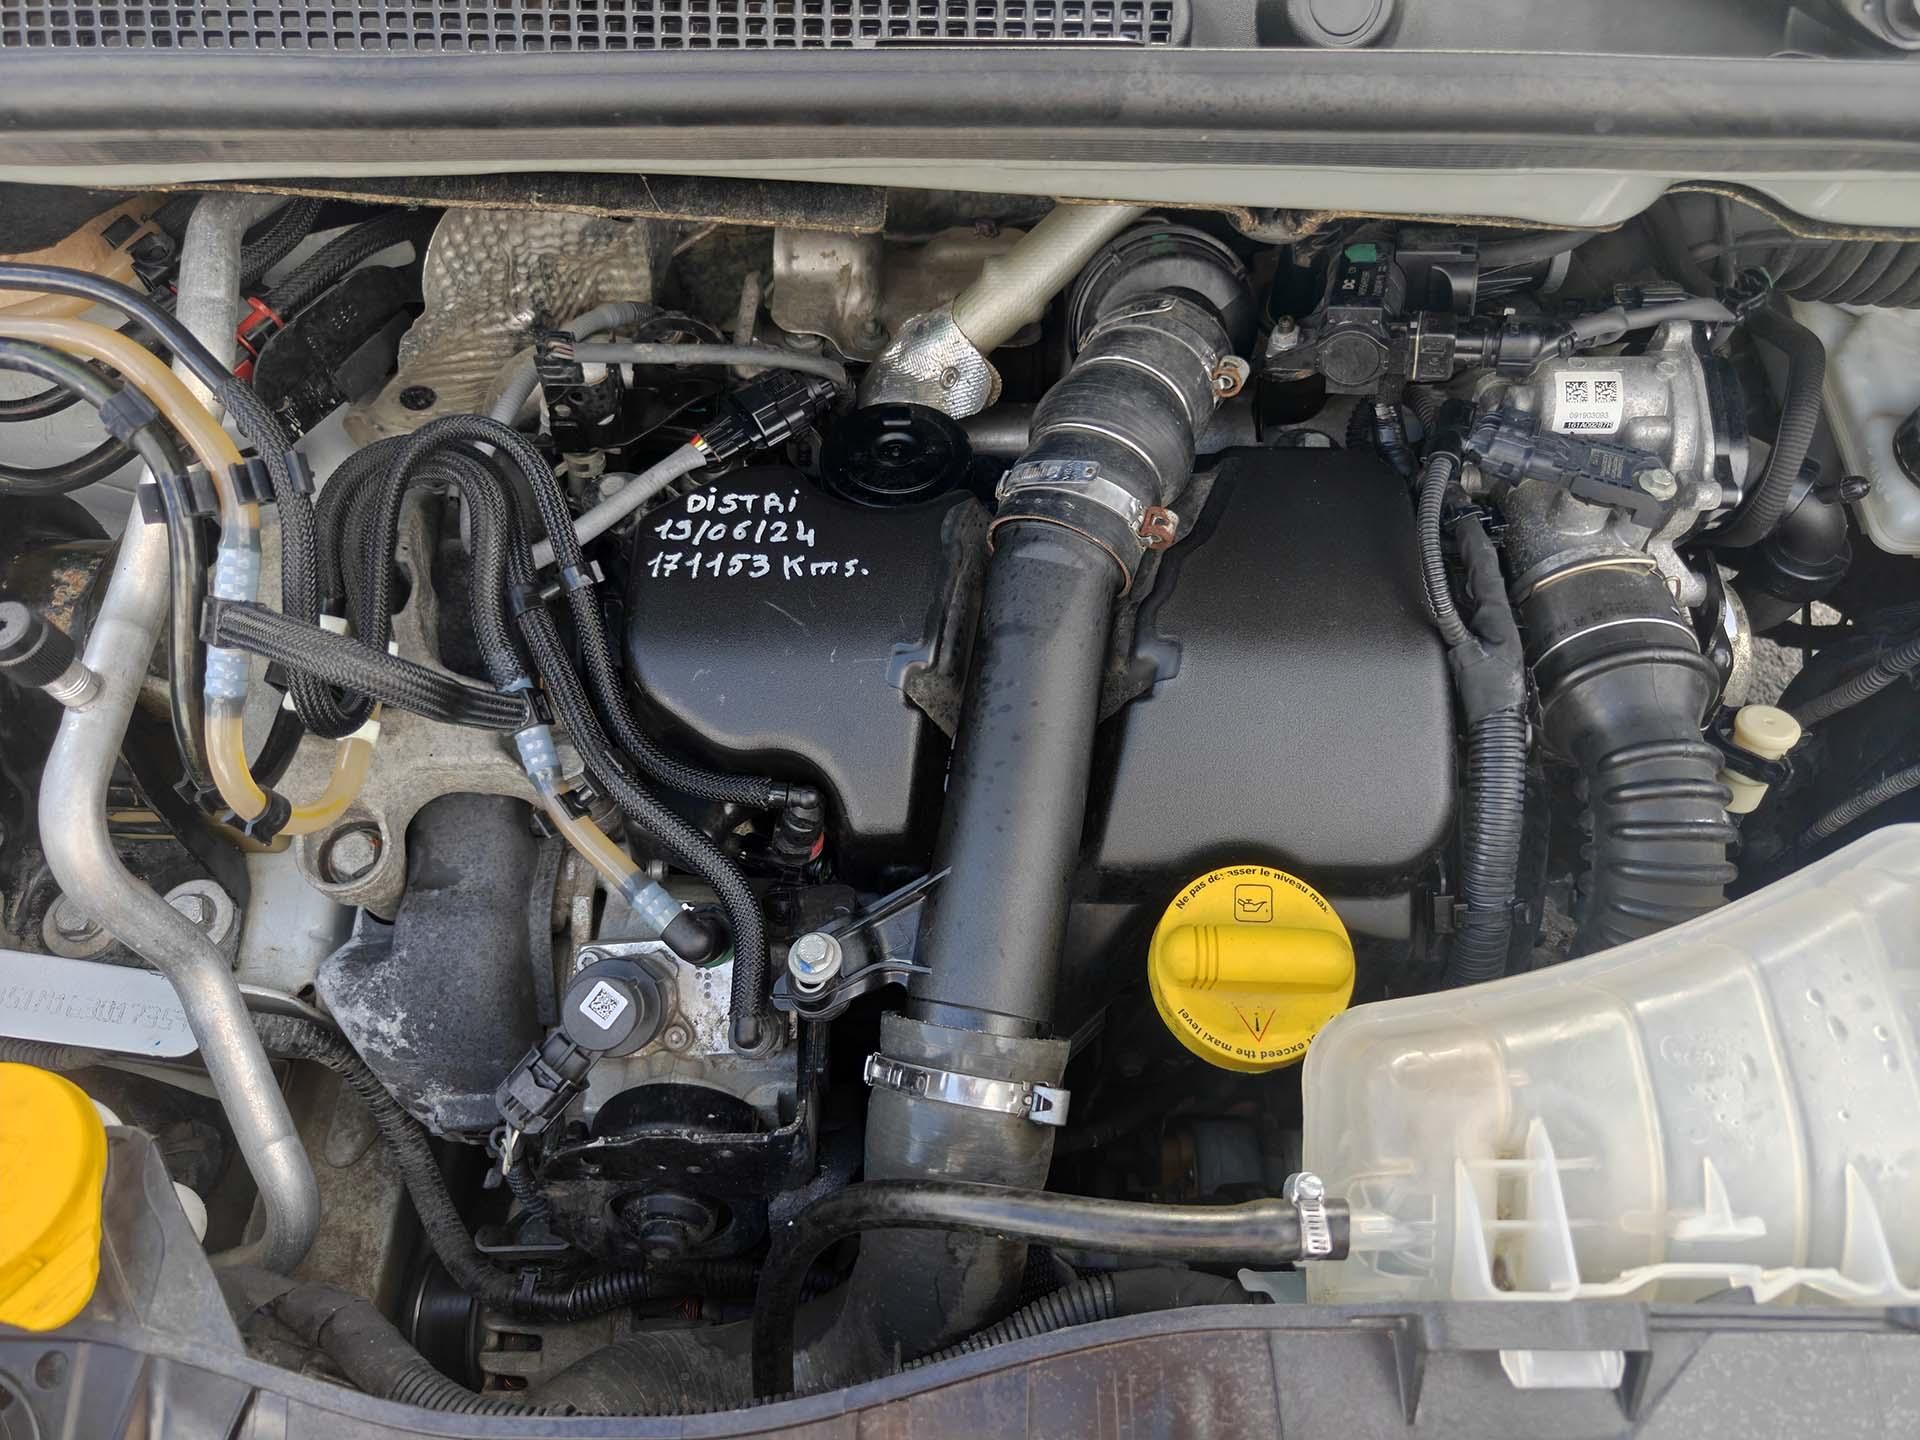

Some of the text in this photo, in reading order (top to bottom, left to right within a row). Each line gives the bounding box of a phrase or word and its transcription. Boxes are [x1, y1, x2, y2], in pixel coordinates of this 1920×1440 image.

[648, 552, 770, 579] 171153
[1175, 895, 1190, 910] Ne
[1189, 880, 1207, 898] pas
[1260, 868, 1270, 877] le
[1273, 873, 1309, 894] niveau
[1178, 1008, 1305, 1060] exceed the maxi level
